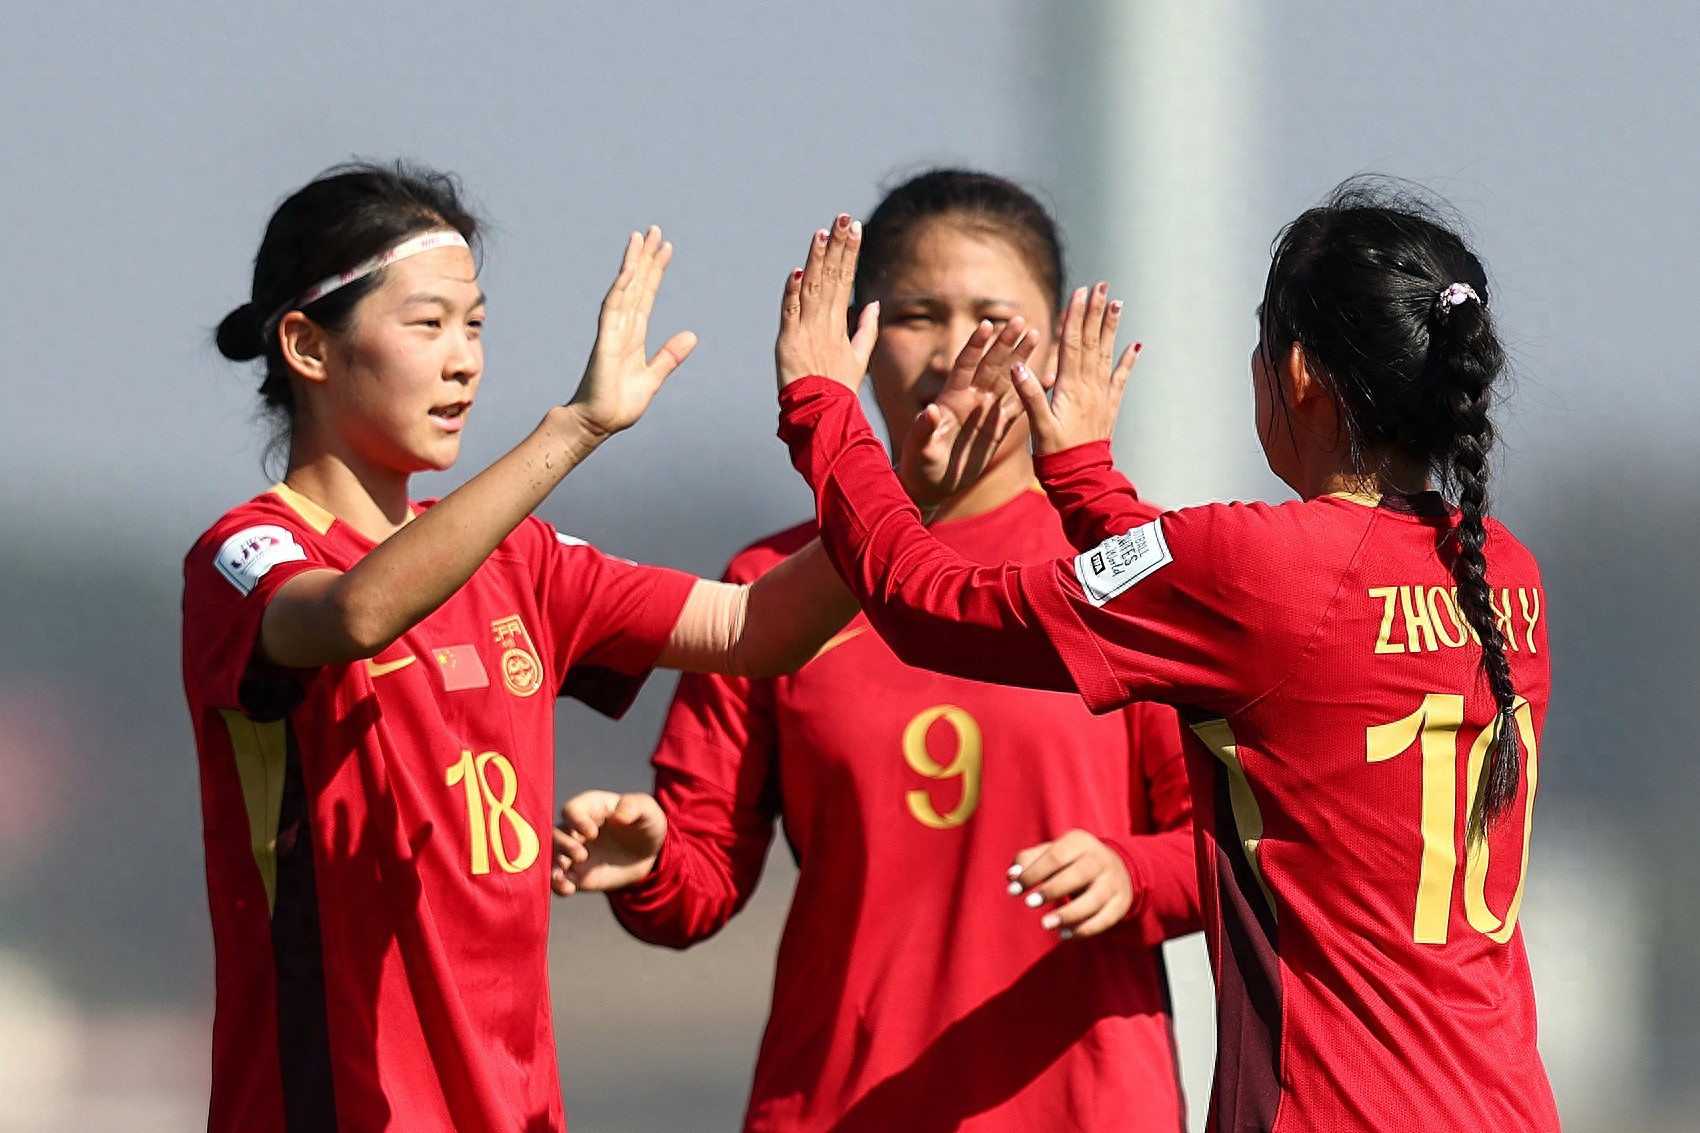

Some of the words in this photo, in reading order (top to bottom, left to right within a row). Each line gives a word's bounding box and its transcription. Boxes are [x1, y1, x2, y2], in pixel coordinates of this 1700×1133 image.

[445, 750, 540, 875] 18
[903, 704, 983, 830] 9
[1366, 693, 1540, 945] 10
